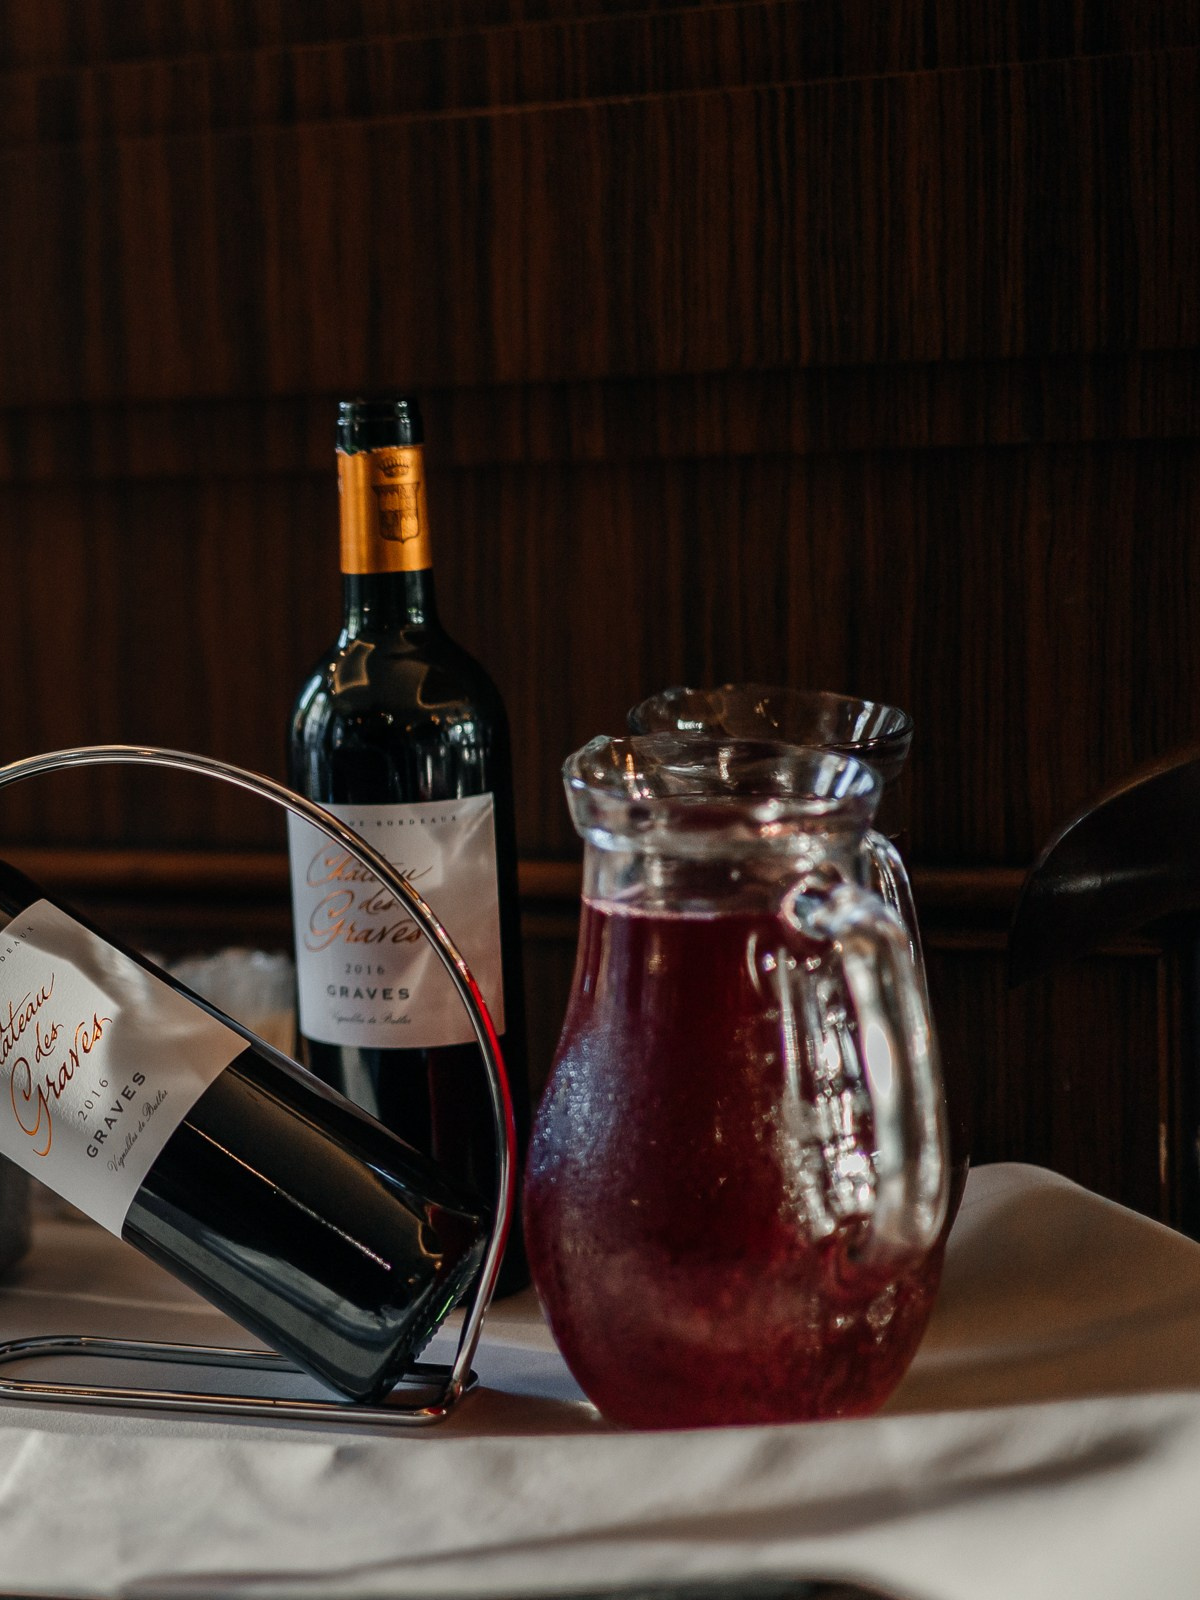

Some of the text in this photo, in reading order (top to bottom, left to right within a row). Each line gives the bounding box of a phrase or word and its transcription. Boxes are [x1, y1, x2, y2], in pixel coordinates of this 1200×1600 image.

[357, 886, 400, 915] des
[344, 963, 386, 976] 2016
[326, 984, 411, 1001] GRAVES
[35, 1021, 65, 1063] des
[10, 1012, 113, 1157] Graves
[77, 1078, 109, 1121] 2016
[86, 1072, 146, 1158] GRAVES
[138, 1120, 146, 1133] de
